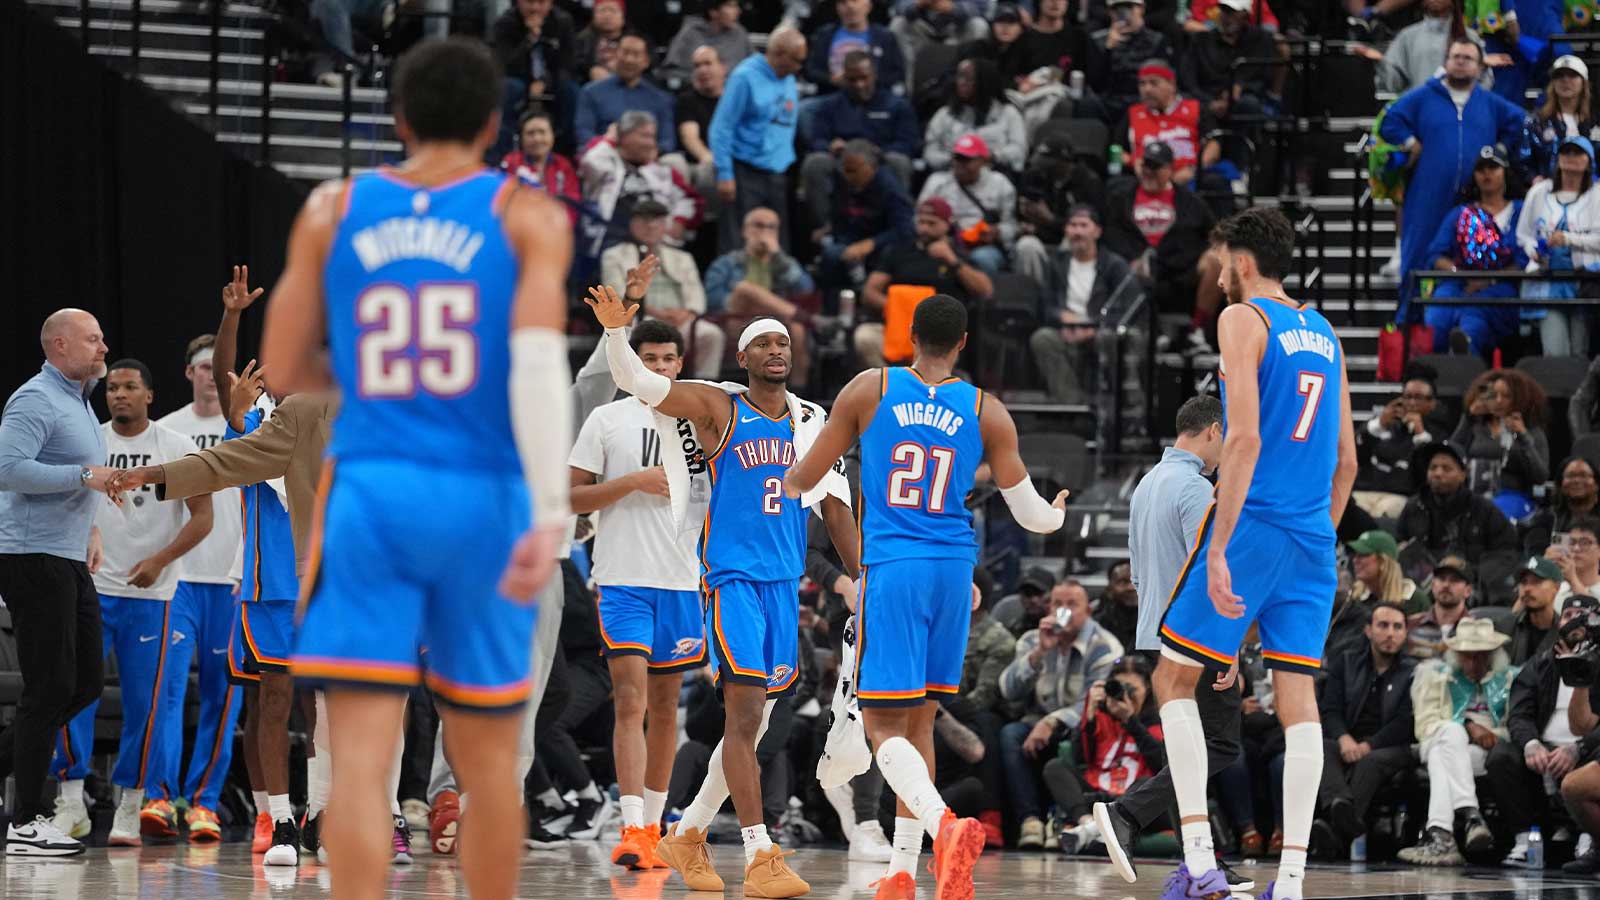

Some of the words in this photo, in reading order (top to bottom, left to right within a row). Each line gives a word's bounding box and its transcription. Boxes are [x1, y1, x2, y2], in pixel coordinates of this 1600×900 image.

[357, 281, 479, 400] 25
[1277, 329, 1335, 364] HOLMGREN
[892, 402, 964, 436] WIGGINS
[1290, 370, 1326, 442] 7
[733, 437, 798, 471] THUND
[763, 476, 782, 515] 2
[887, 441, 956, 513] 21
